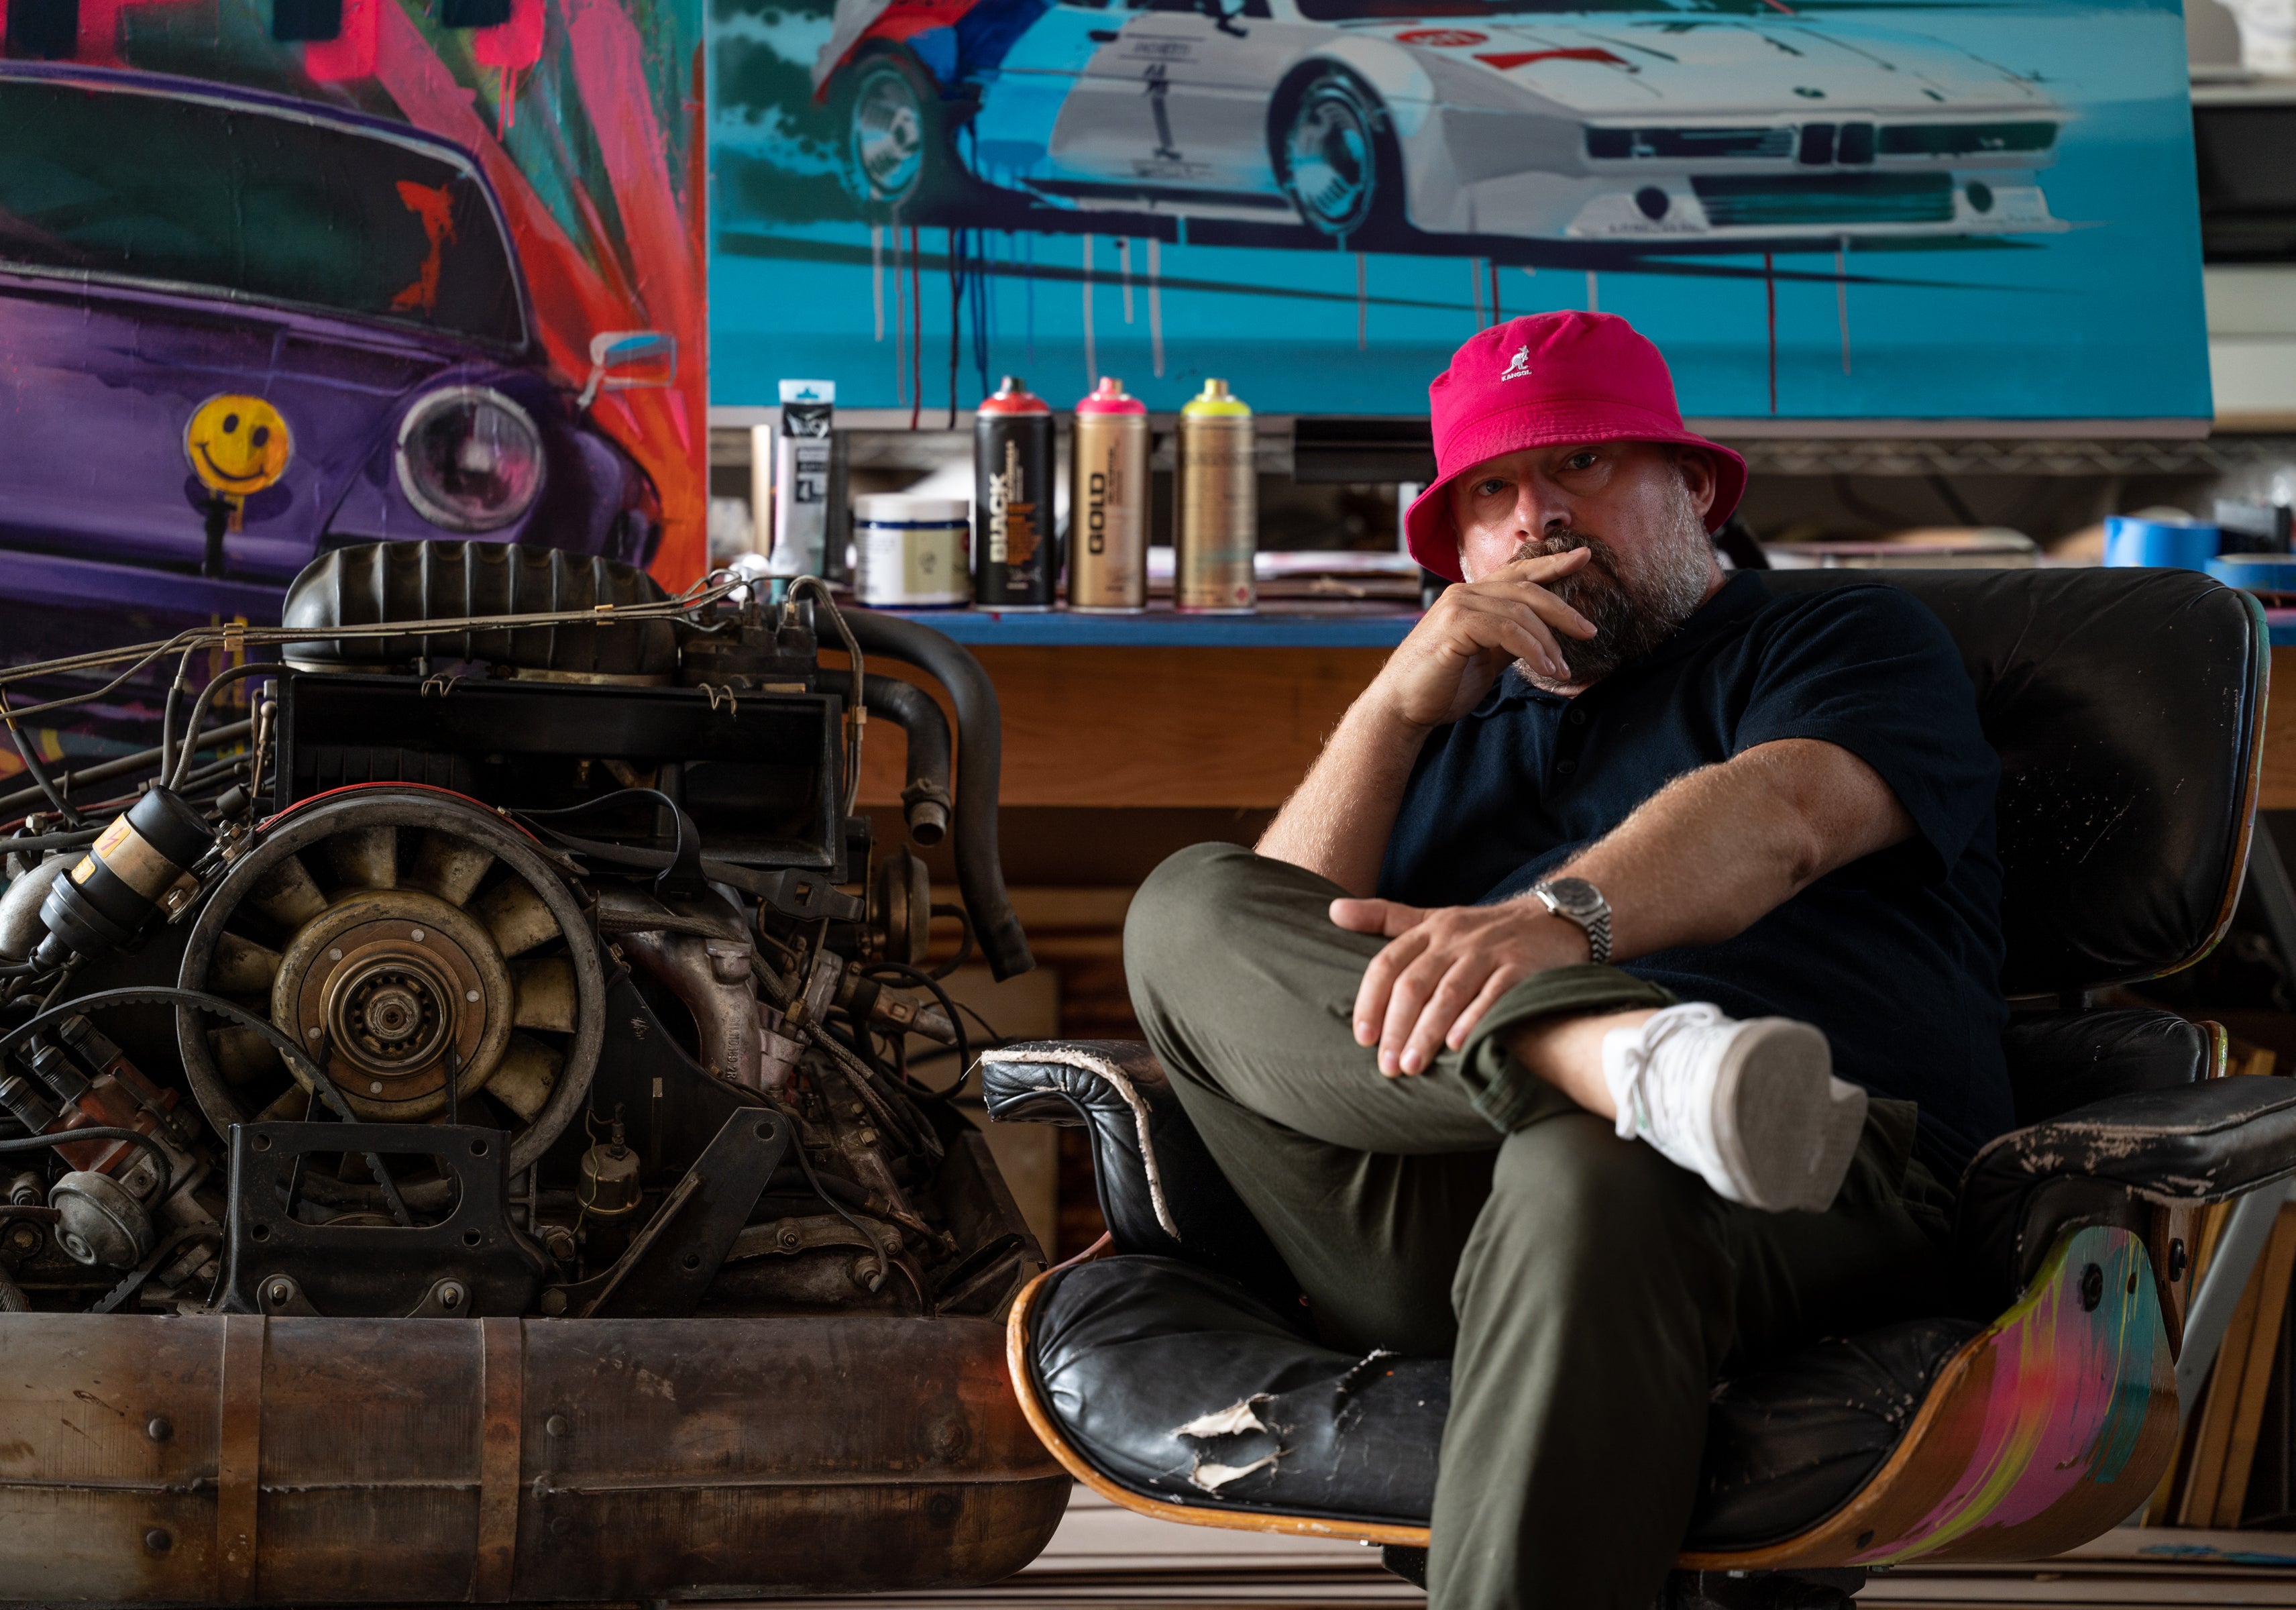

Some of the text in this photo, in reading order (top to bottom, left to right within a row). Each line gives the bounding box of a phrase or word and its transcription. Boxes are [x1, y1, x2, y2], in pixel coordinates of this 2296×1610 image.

[1501, 370, 1532, 382] KANGOL
[989, 472, 1007, 563] BLACK
[1089, 472, 1104, 555] GOLD
